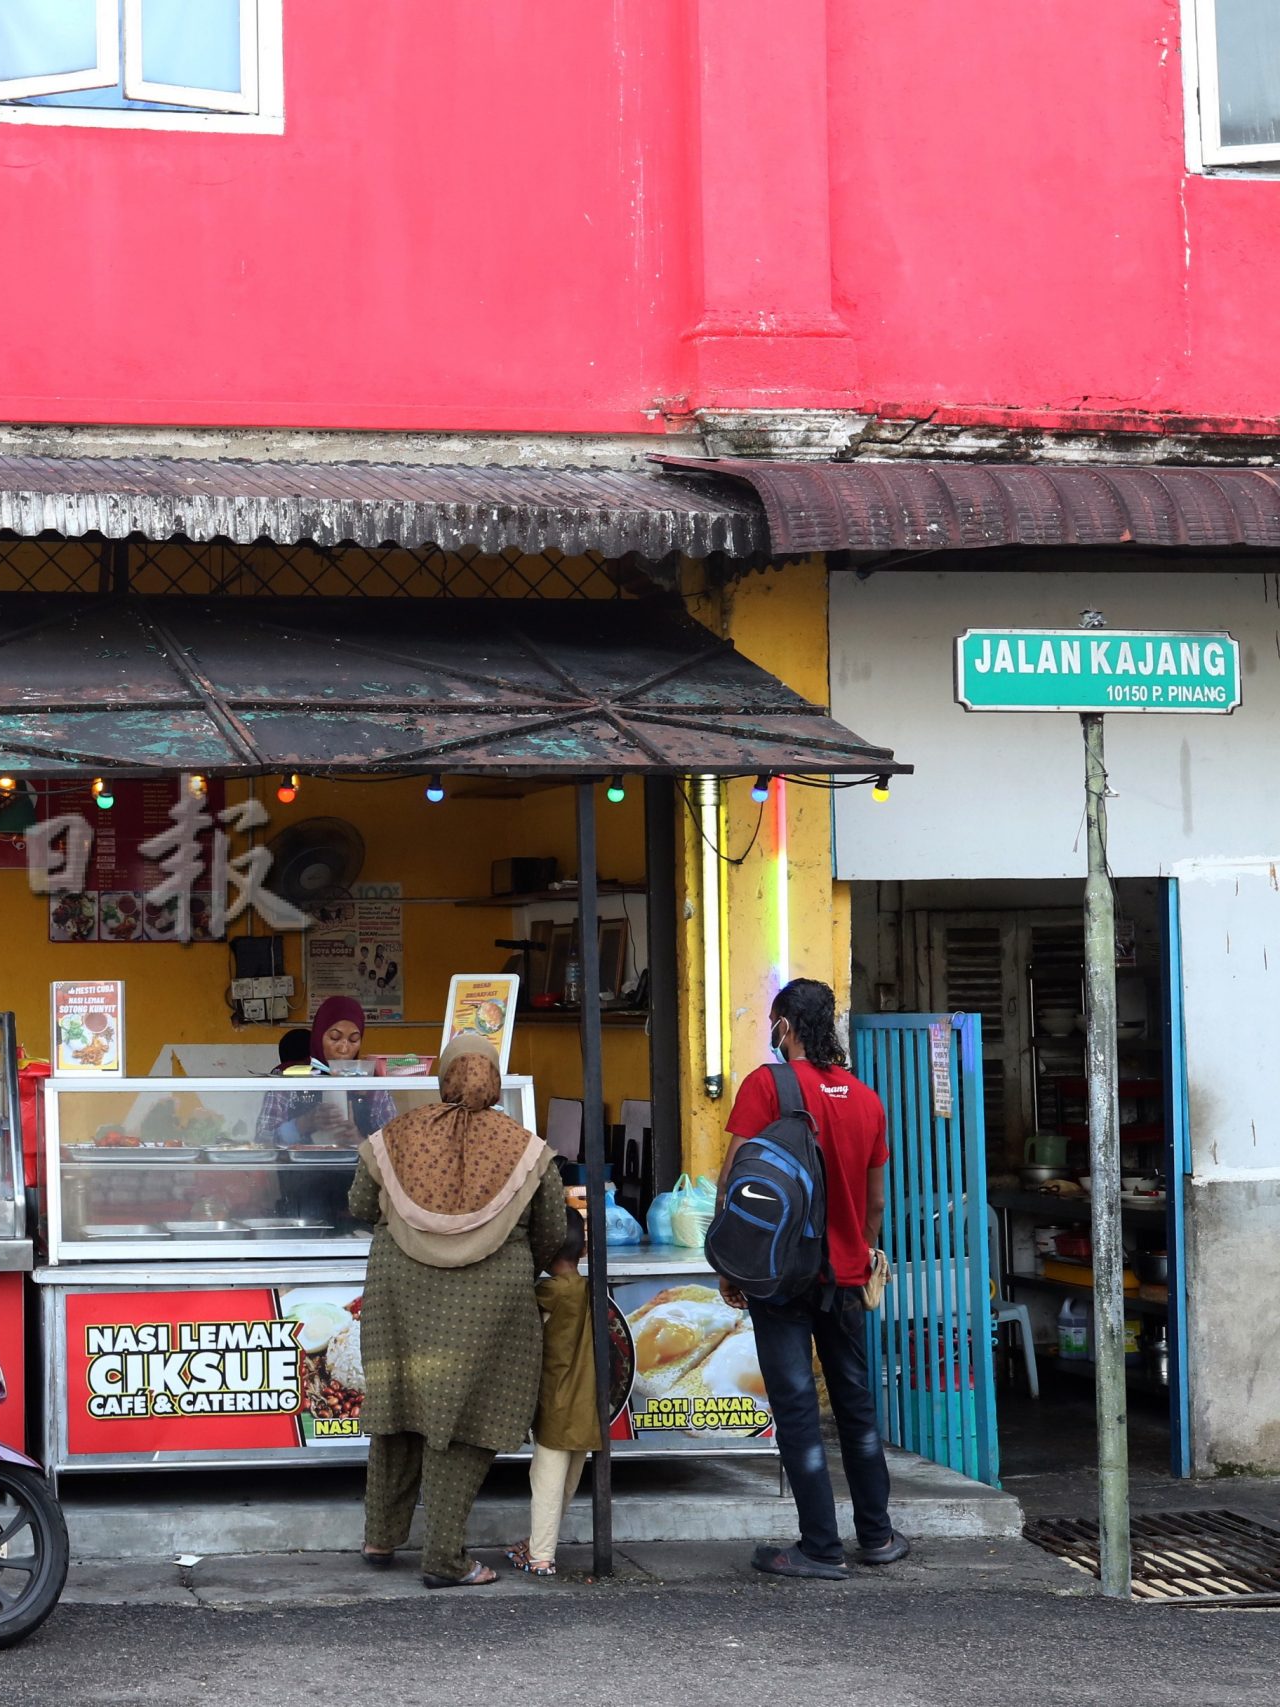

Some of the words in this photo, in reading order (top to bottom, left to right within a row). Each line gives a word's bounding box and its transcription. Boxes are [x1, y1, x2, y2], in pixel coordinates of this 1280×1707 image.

[974, 639, 1081, 674] JALAN
[1091, 641, 1225, 676] KAJANG
[1106, 685, 1147, 701] 10150
[1152, 686, 1164, 702] P.
[1168, 686, 1226, 702] PINANG
[75, 986, 96, 995] MESTI
[59, 1004, 88, 1013] SOTONG
[88, 1004, 117, 1013] KUNYIT
[88, 1325, 170, 1353] NASI
[180, 1322, 296, 1351] LEMAK
[88, 1351, 297, 1395] CIKSUE
[89, 1389, 148, 1414] CAFÉ
[153, 1392, 176, 1413] &
[179, 1391, 297, 1412] CATERING
[647, 1398, 689, 1413] ROTI
[693, 1397, 754, 1412] BAKAR
[316, 1420, 358, 1435] NASI
[633, 1412, 688, 1428] TELUR
[691, 1411, 768, 1427] GOYANG
